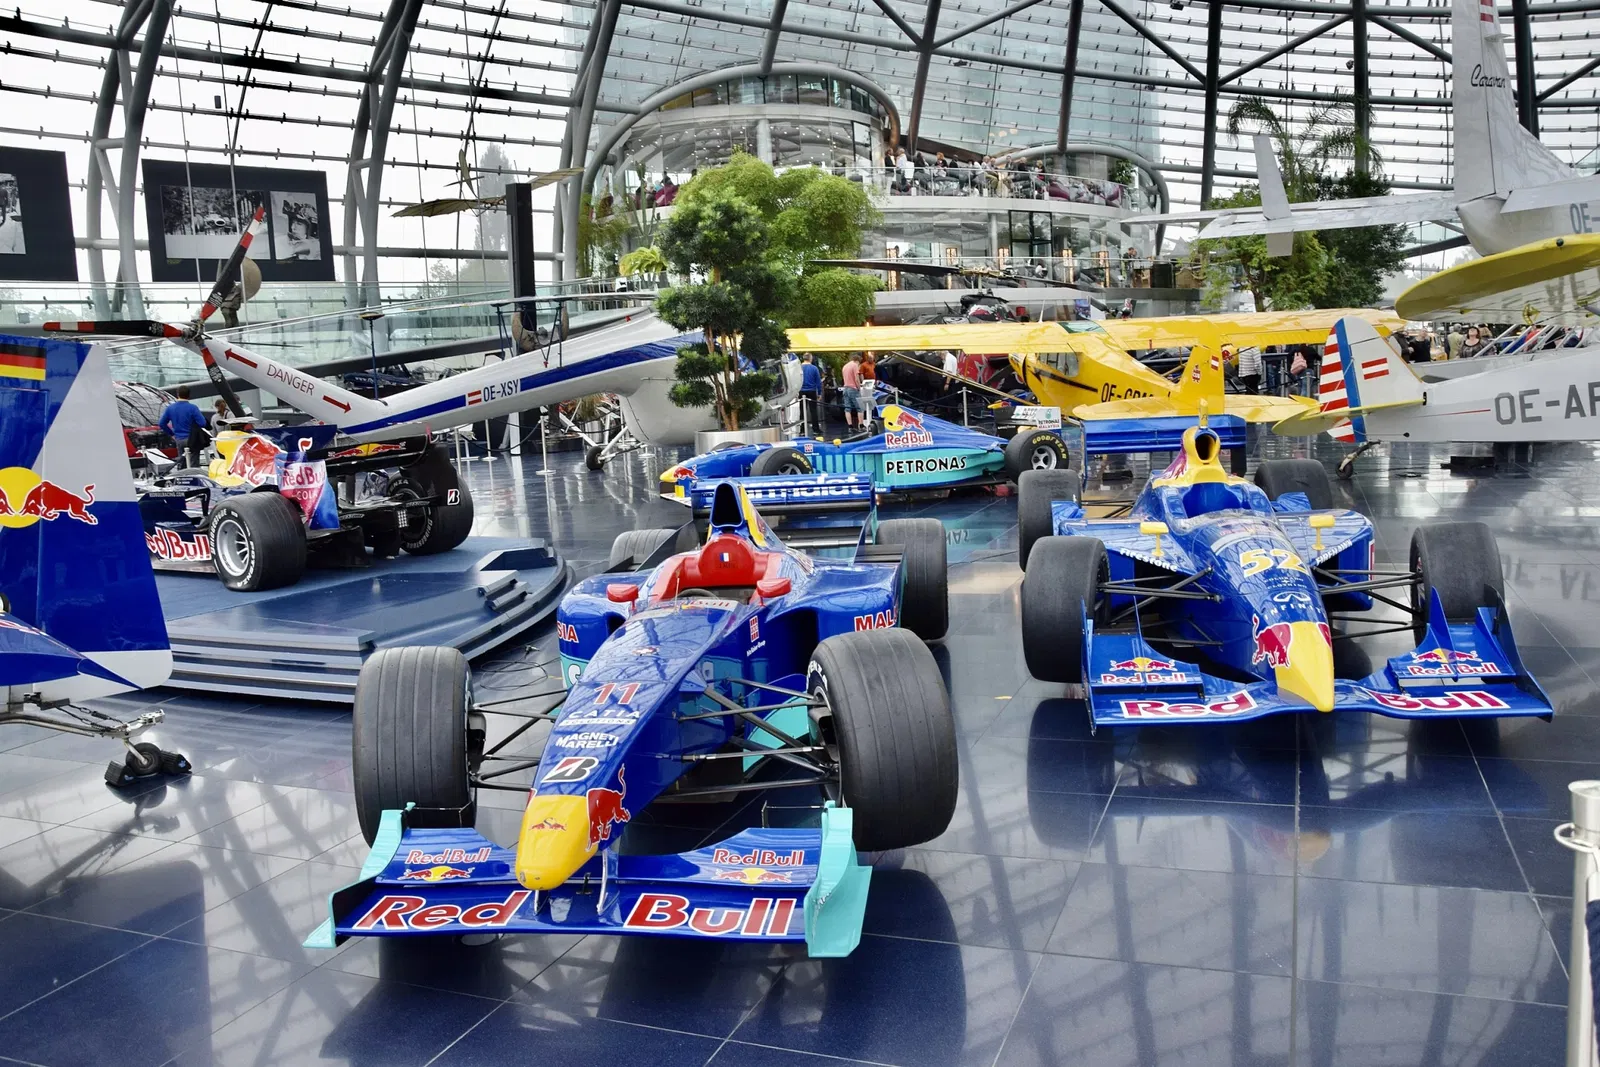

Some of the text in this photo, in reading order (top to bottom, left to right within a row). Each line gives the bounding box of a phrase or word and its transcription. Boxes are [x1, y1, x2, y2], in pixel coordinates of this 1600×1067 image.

[266, 363, 316, 396] DANGER
[483, 379, 519, 402] OE-XSY
[886, 431, 933, 446] Red Bull
[791, 452, 812, 474] GOOD
[886, 456, 967, 475] PETRONAS
[742, 472, 862, 499] rmalat
[144, 526, 212, 561] ed Bull
[1119, 547, 1178, 573] Firestone
[1239, 548, 1310, 579] 52
[1101, 672, 1187, 684] Red Bull
[1407, 662, 1501, 676] Red Bull
[593, 682, 641, 705] 11
[1120, 690, 1258, 719] Red
[1366, 687, 1511, 711] Bull
[568, 709, 640, 718] CATIA
[404, 847, 491, 865] Red Bull
[712, 848, 804, 867] Red Bull
[351, 889, 798, 937] Red Bull
